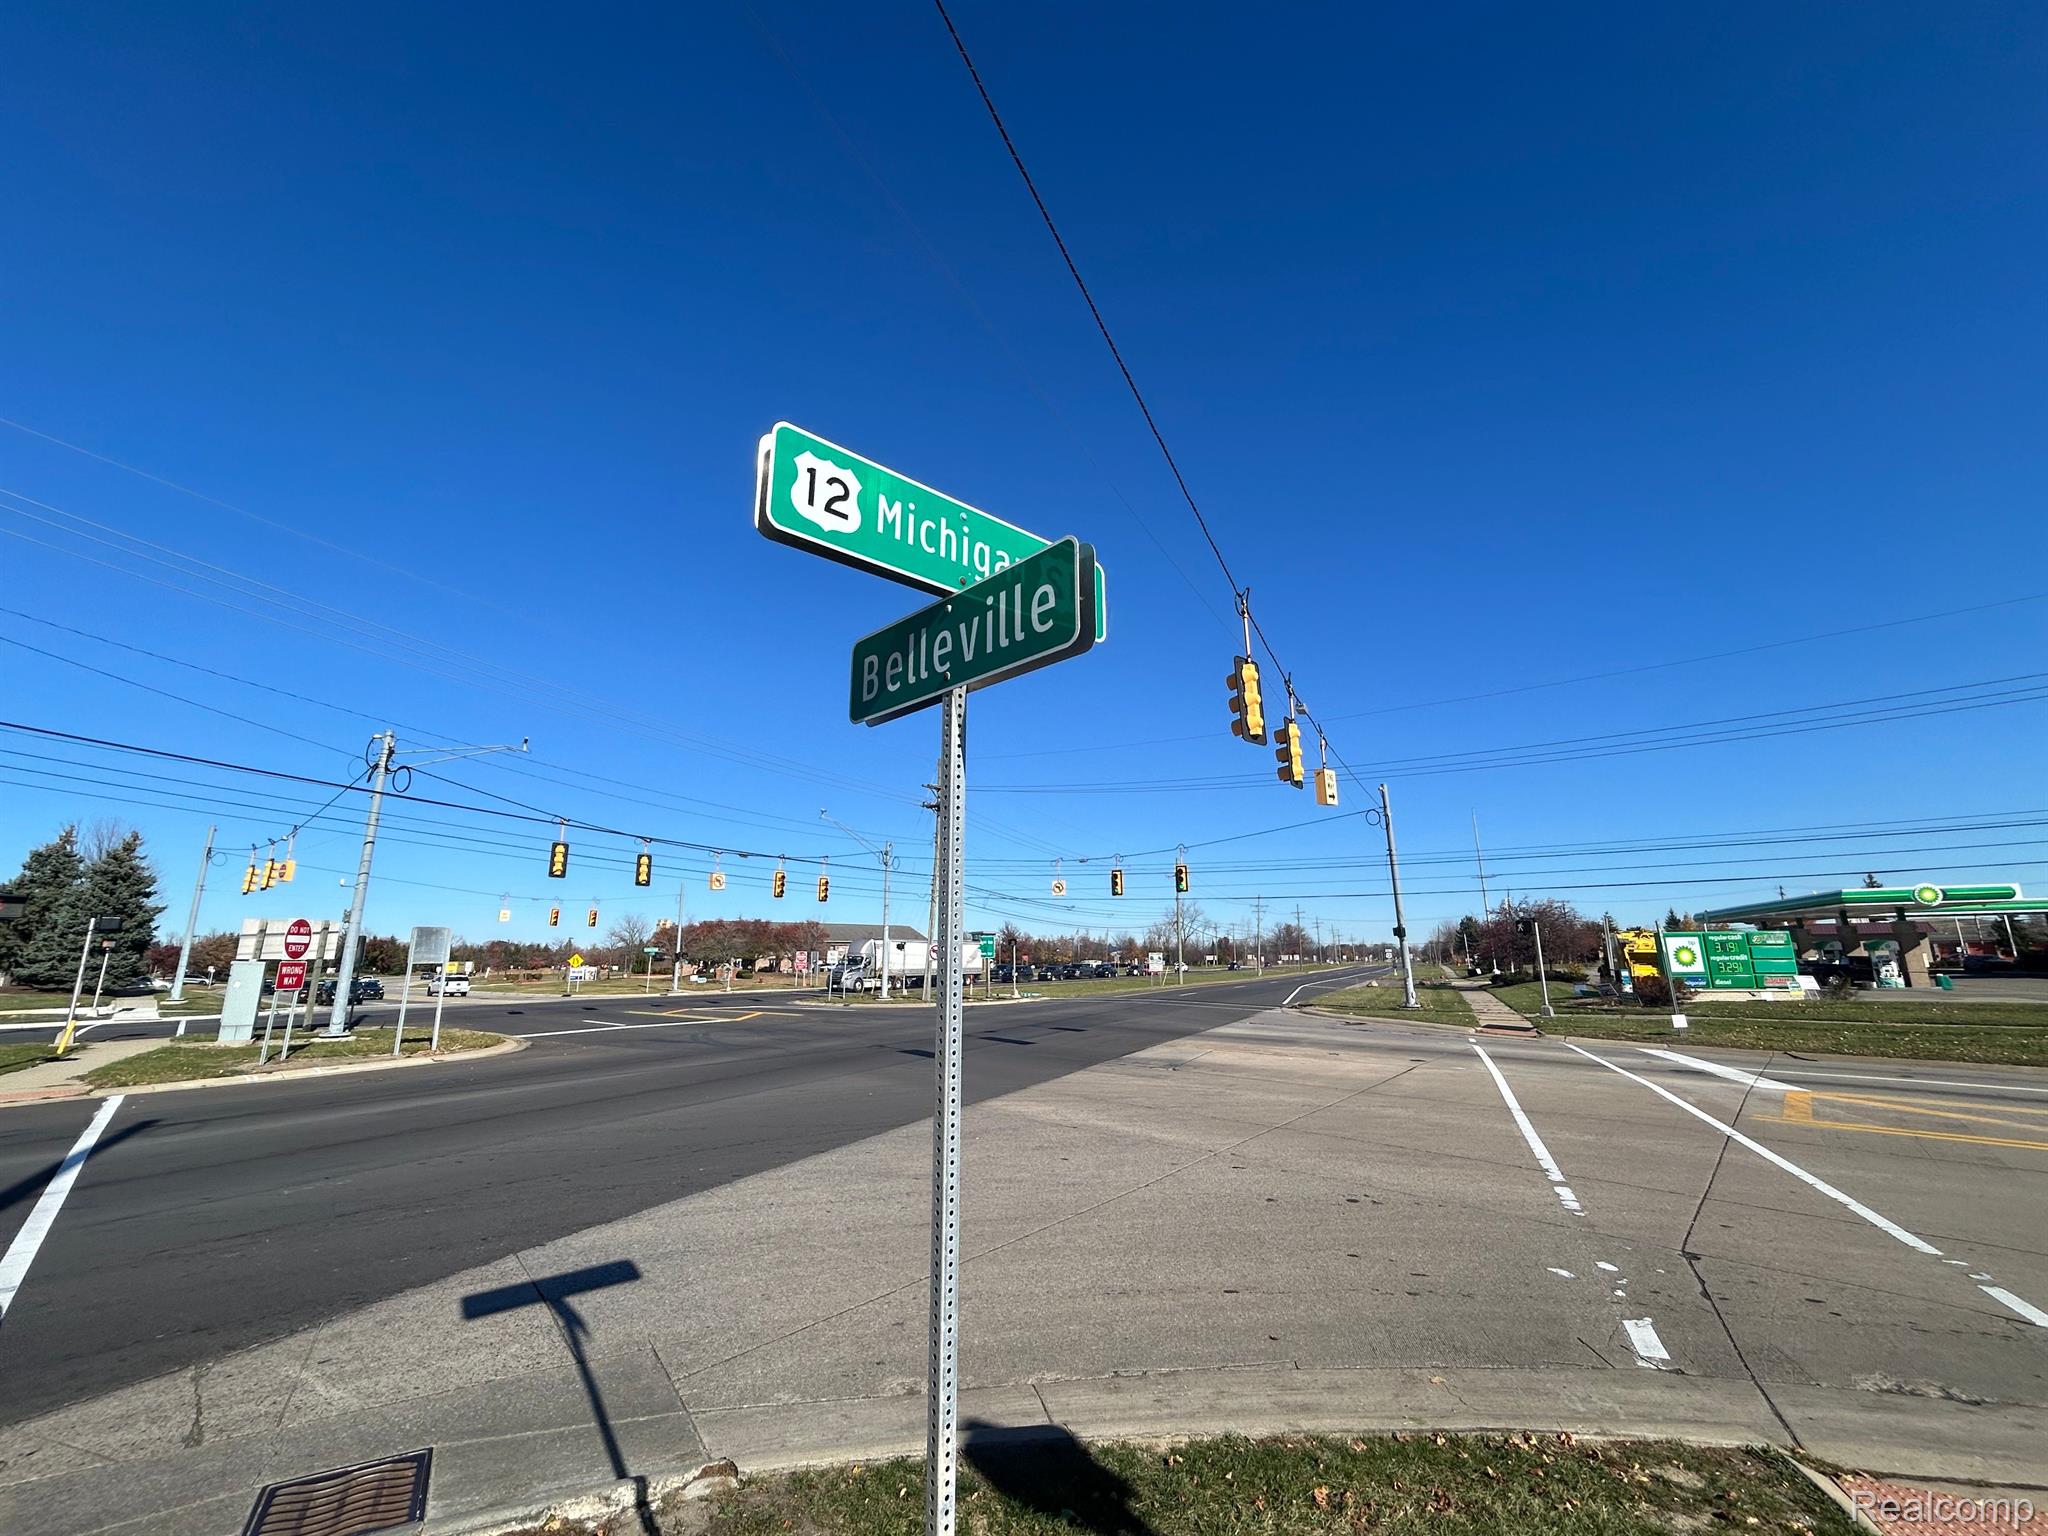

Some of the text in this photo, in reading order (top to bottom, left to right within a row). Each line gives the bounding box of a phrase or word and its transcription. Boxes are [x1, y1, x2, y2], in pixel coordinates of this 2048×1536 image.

[806, 467, 1022, 582] 12 Michiga
[862, 582, 1056, 703] Belleville
[281, 966, 304, 975] WRONG
[283, 976, 298, 986] WAY
